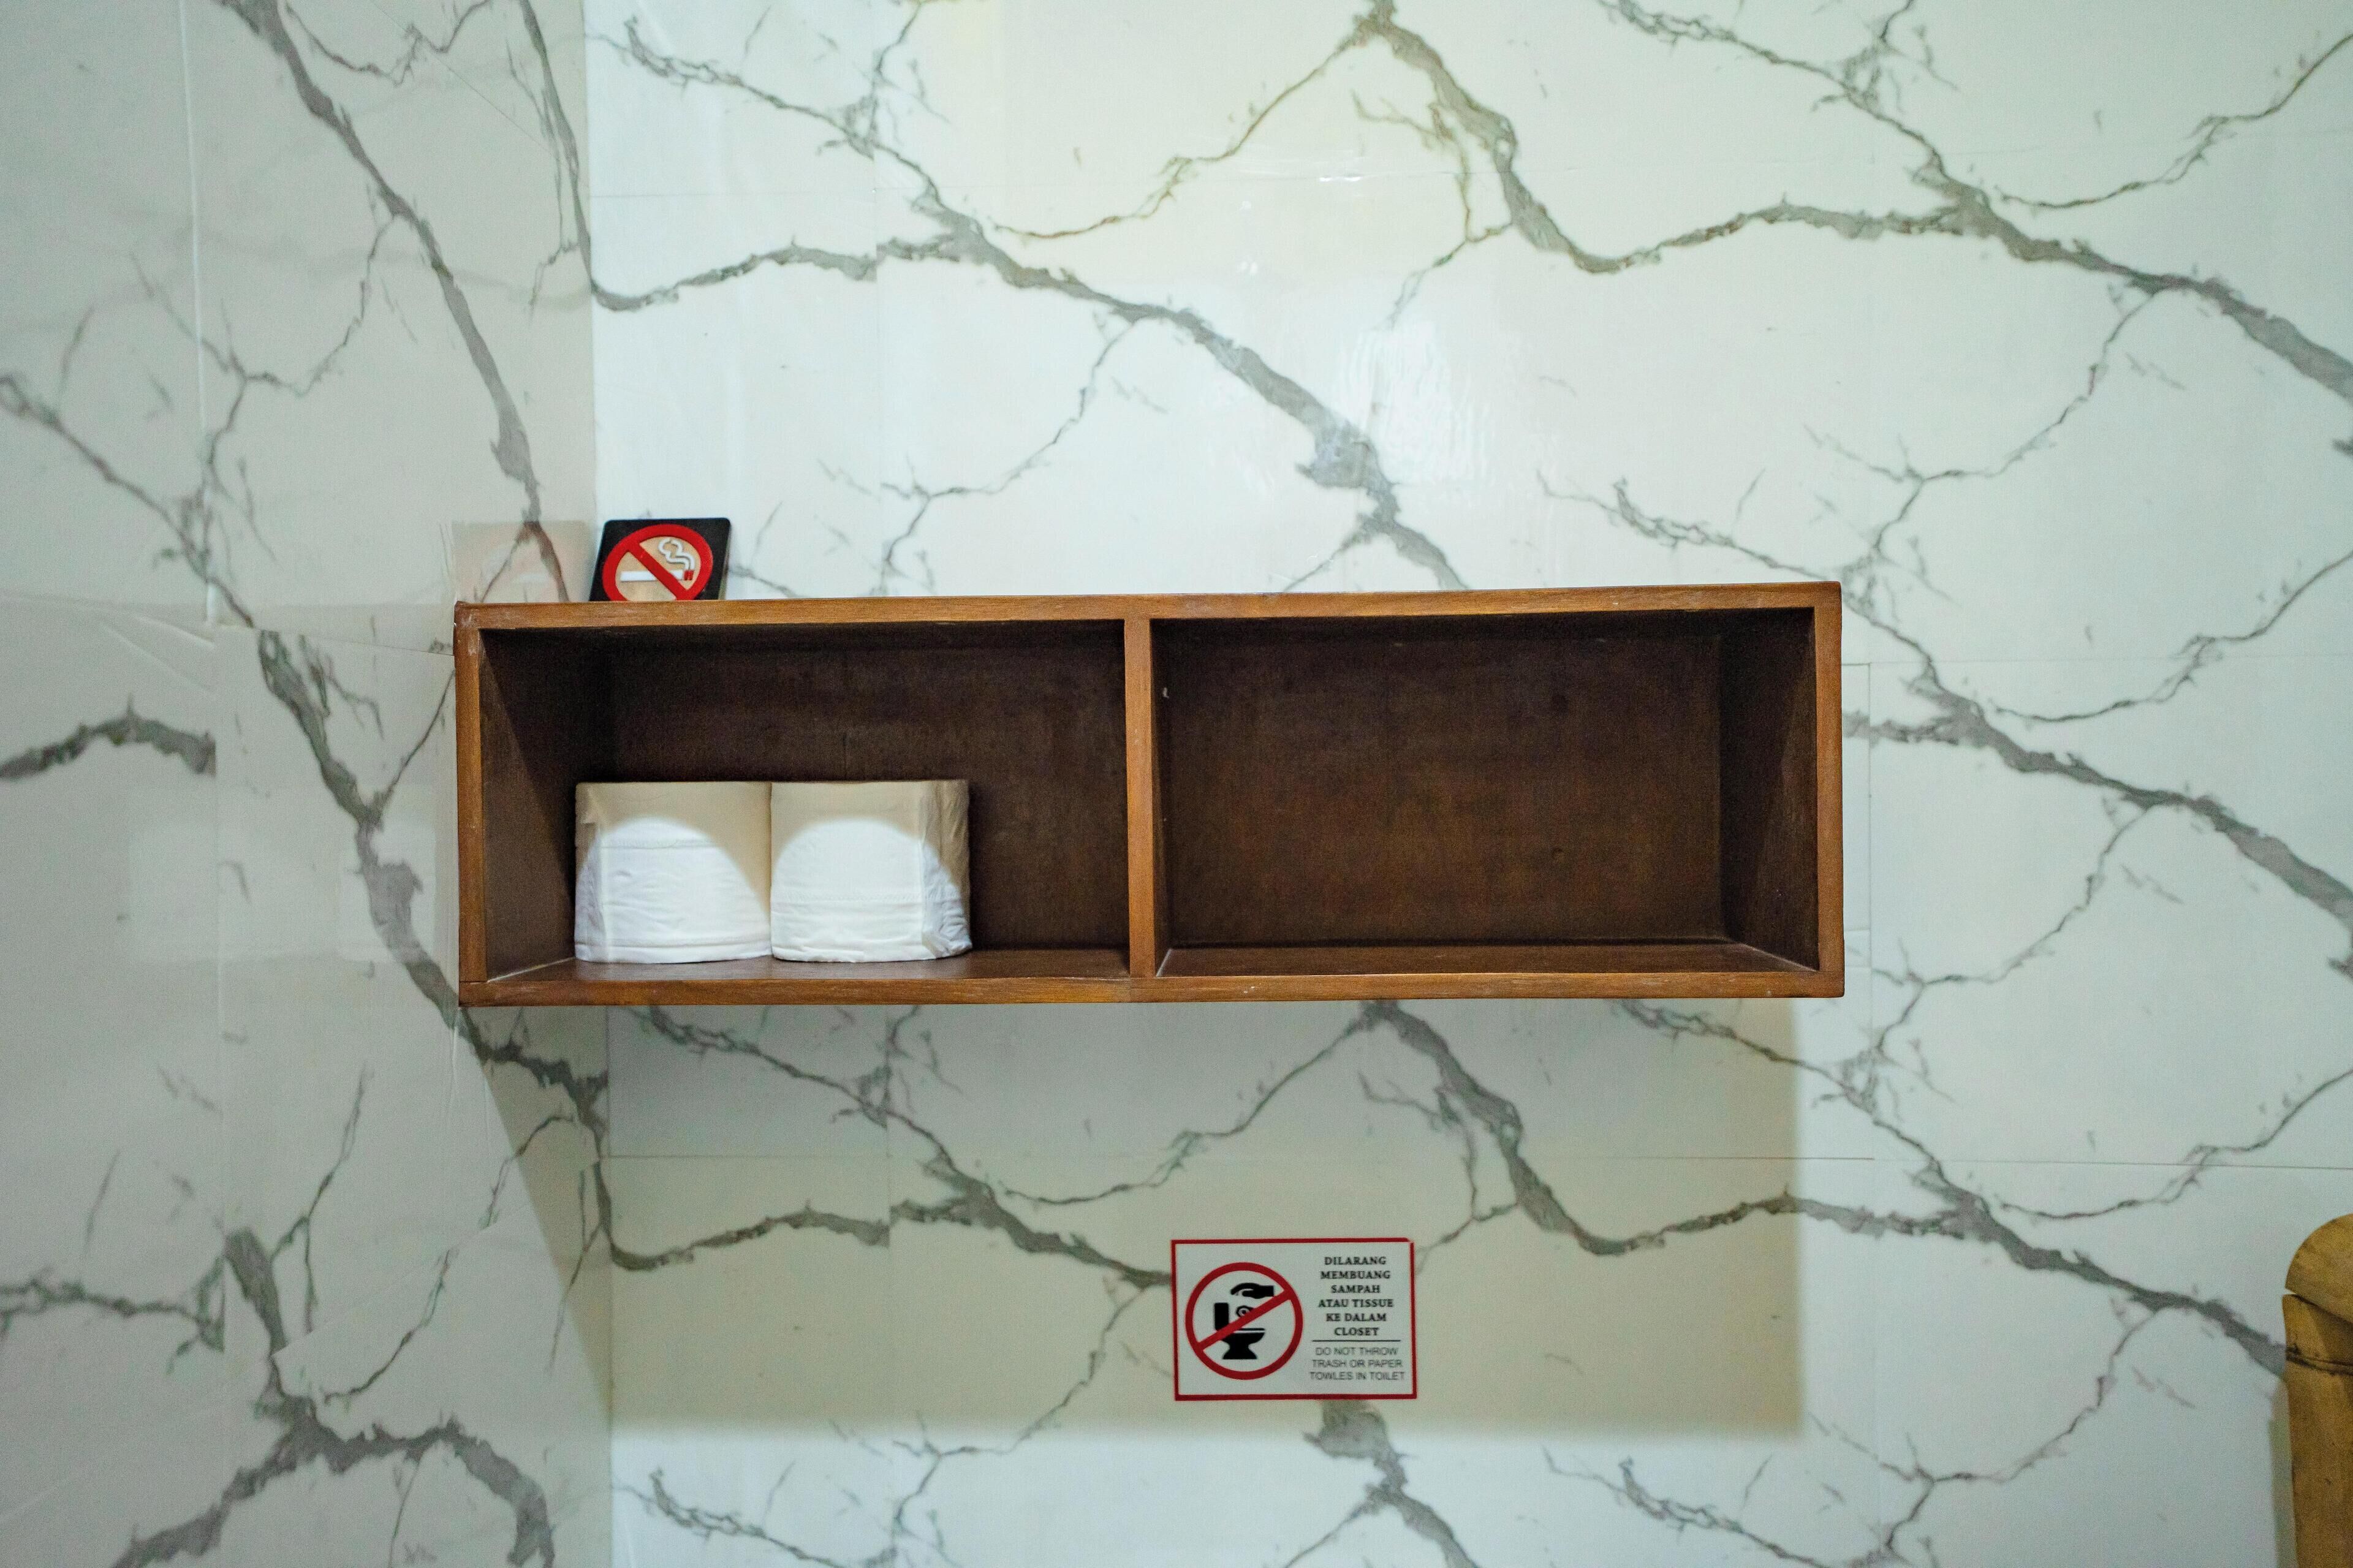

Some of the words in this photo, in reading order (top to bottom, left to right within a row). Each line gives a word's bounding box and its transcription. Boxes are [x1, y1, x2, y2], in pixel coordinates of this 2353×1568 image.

[1324, 1256, 1386, 1265] DILARANG
[1320, 1270, 1390, 1279] MEMBUANG
[1331, 1285, 1380, 1293] SAMPAH
[1319, 1299, 1348, 1308] ATAU
[1352, 1299, 1393, 1308] TISSUE
[1326, 1313, 1341, 1322] KE
[1344, 1313, 1386, 1322] DALAM
[1334, 1327, 1379, 1336] CLOSET
[1368, 1359, 1402, 1368] PAPER
[1310, 1372, 1353, 1381] TOWLES
